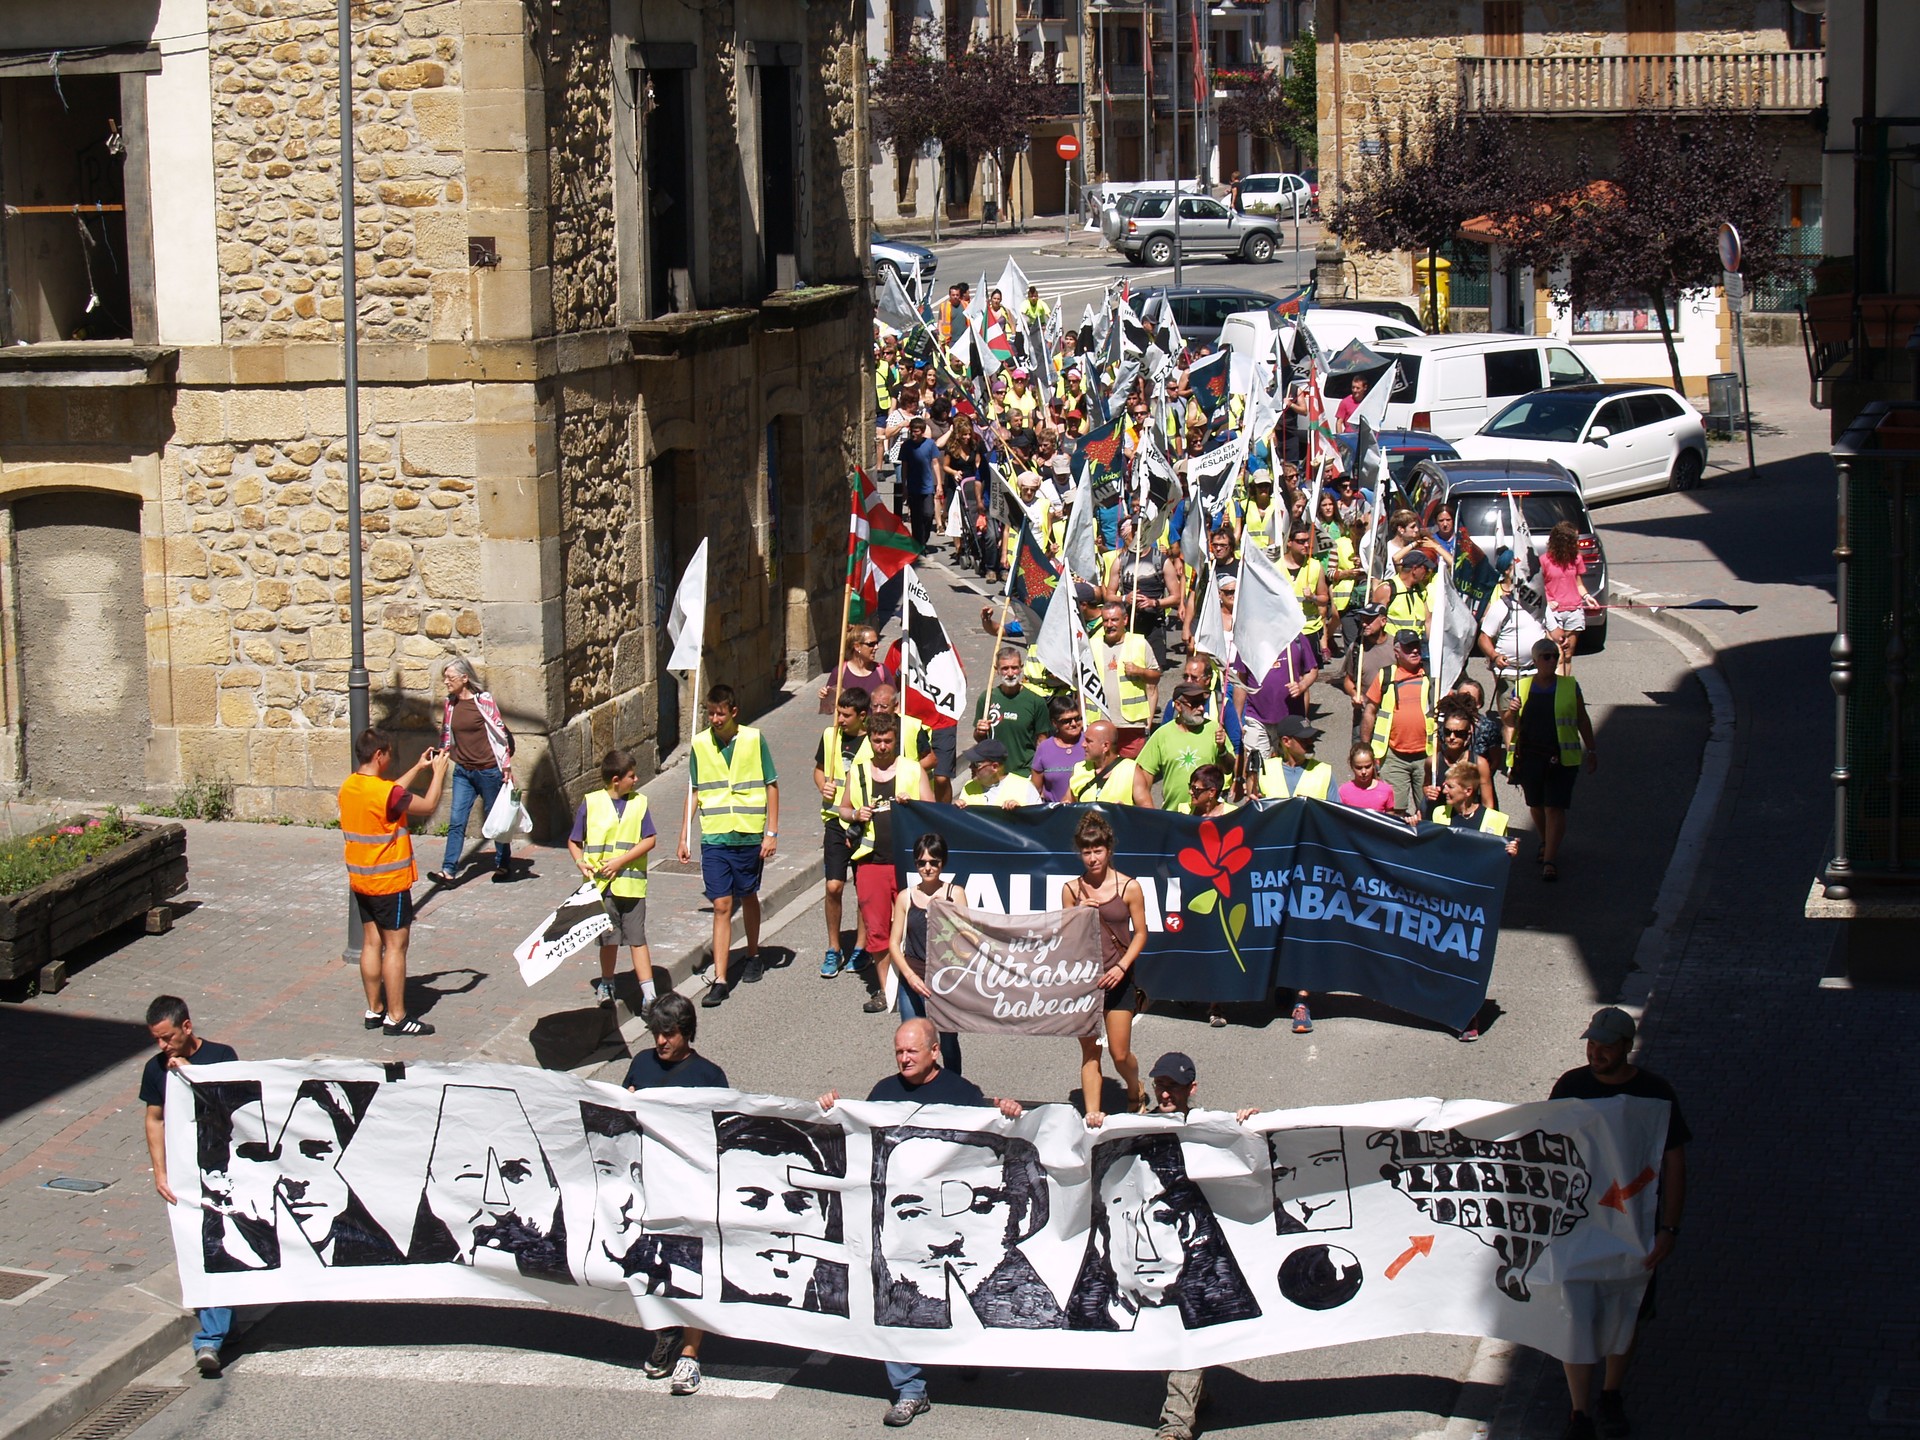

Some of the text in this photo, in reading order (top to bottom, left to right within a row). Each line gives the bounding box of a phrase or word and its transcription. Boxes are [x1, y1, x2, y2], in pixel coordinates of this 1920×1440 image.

[1252, 885, 1484, 962] IRABAZTERA!
[1312, 865, 1346, 889] ETA
[1351, 876, 1486, 925] ASKATASUNA
[1008, 928, 1063, 964] utzi
[992, 990, 1096, 1018] bakean
[193, 1078, 1364, 1334] KALERA!
